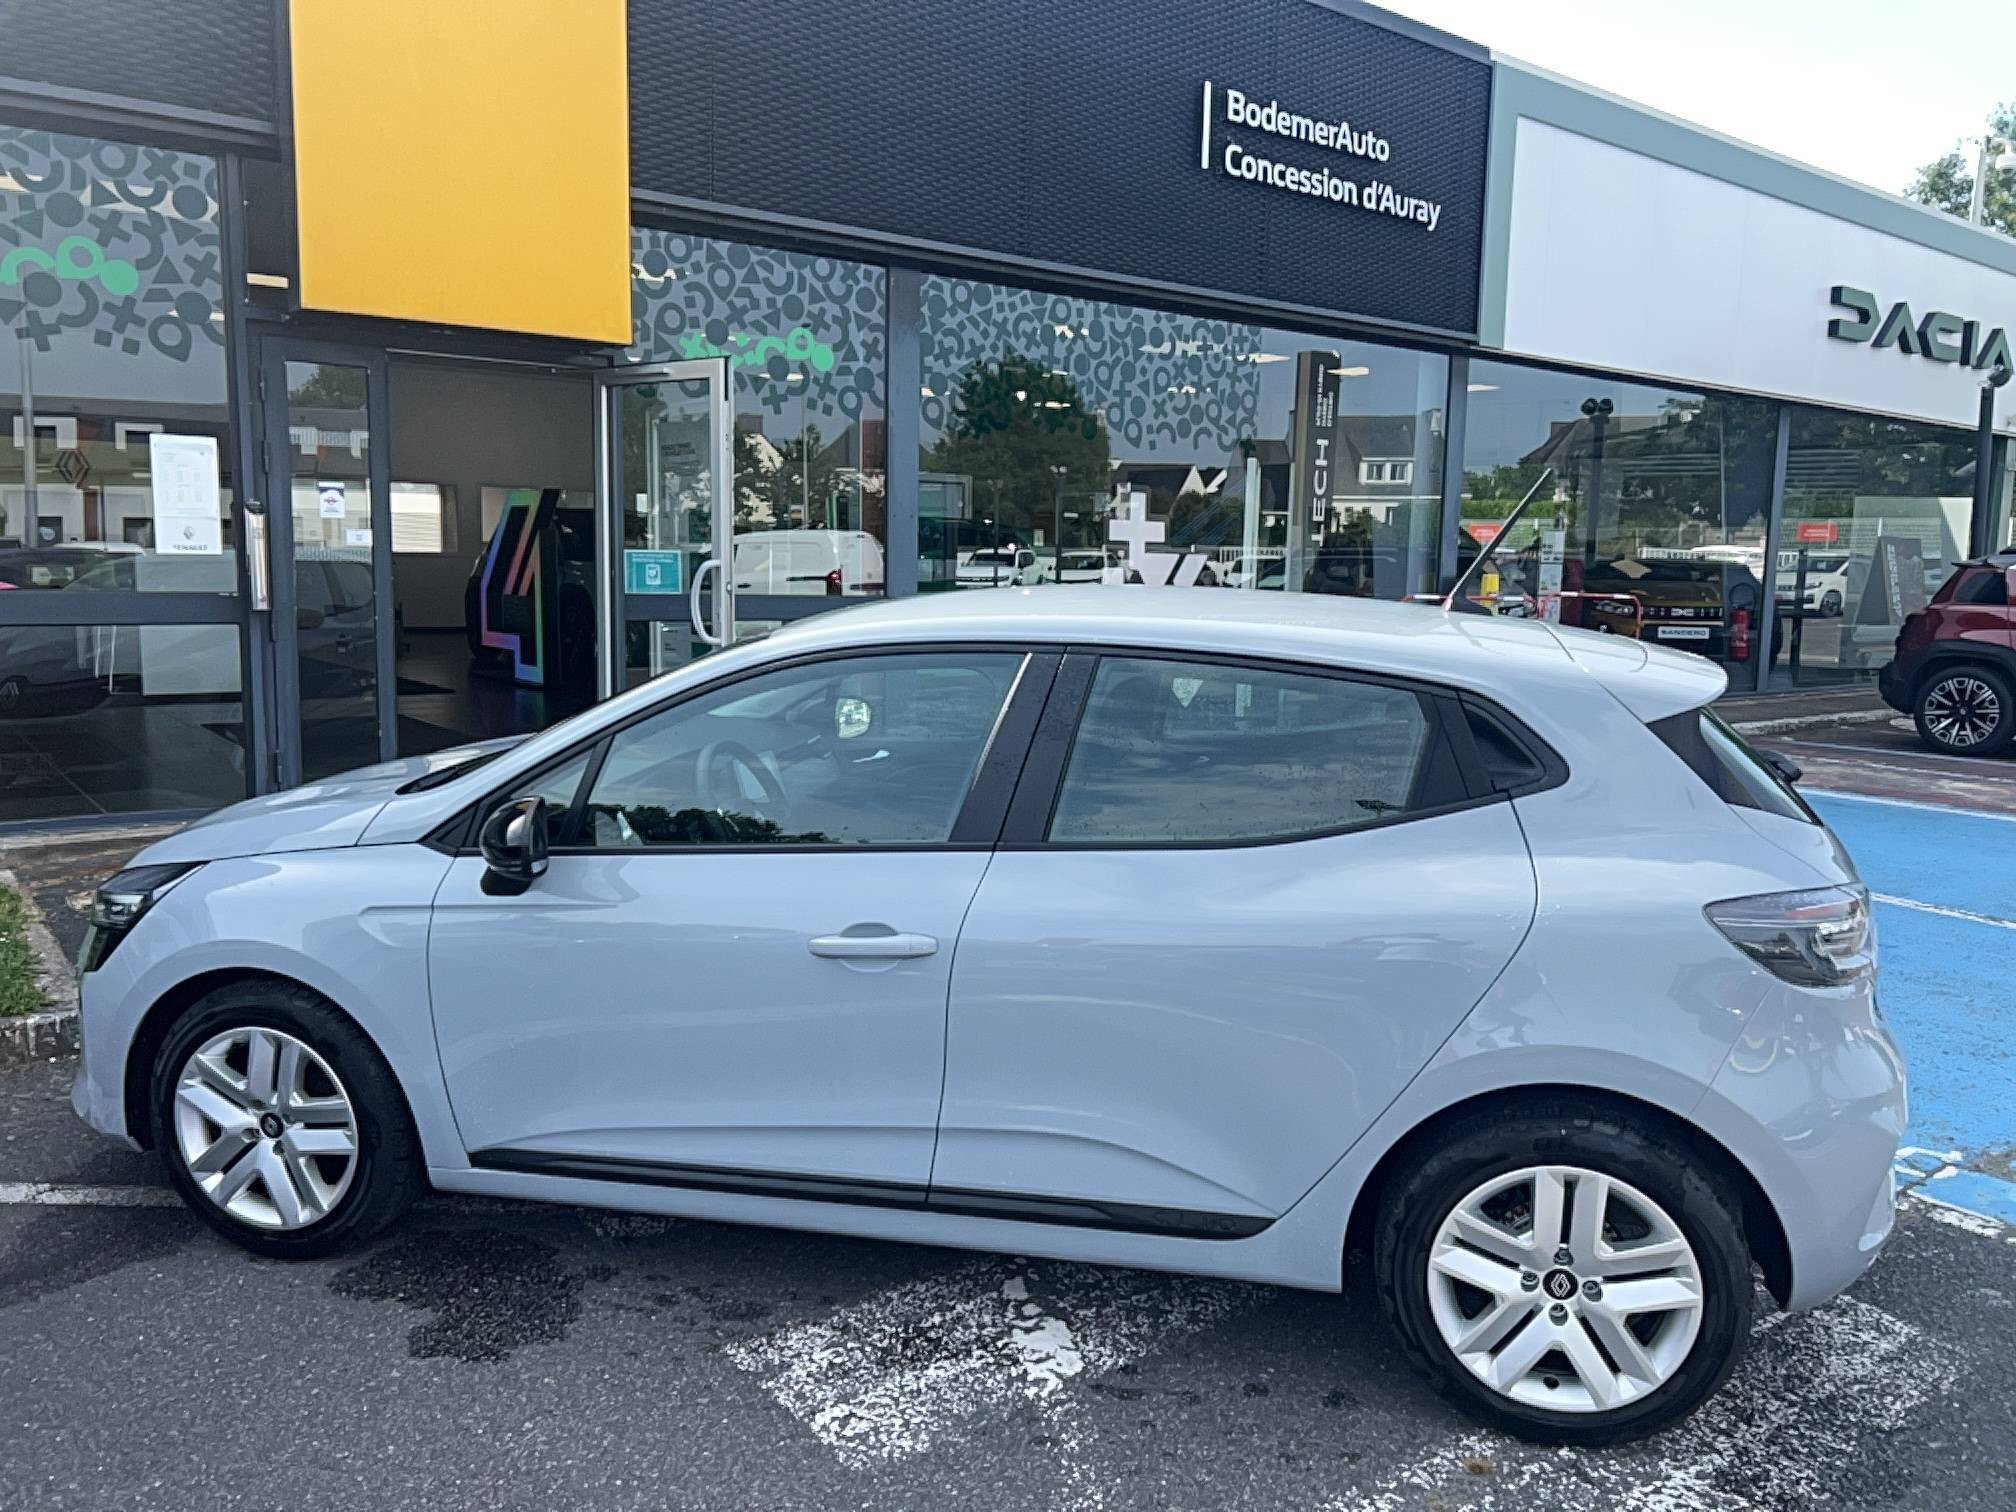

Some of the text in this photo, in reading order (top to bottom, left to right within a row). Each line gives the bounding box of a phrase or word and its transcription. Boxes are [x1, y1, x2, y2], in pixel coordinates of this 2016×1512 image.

[1227, 89, 1390, 162] BodemerAuto
[1225, 144, 1441, 231] Concession d'Auray
[1827, 285, 2015, 374] DACIA
